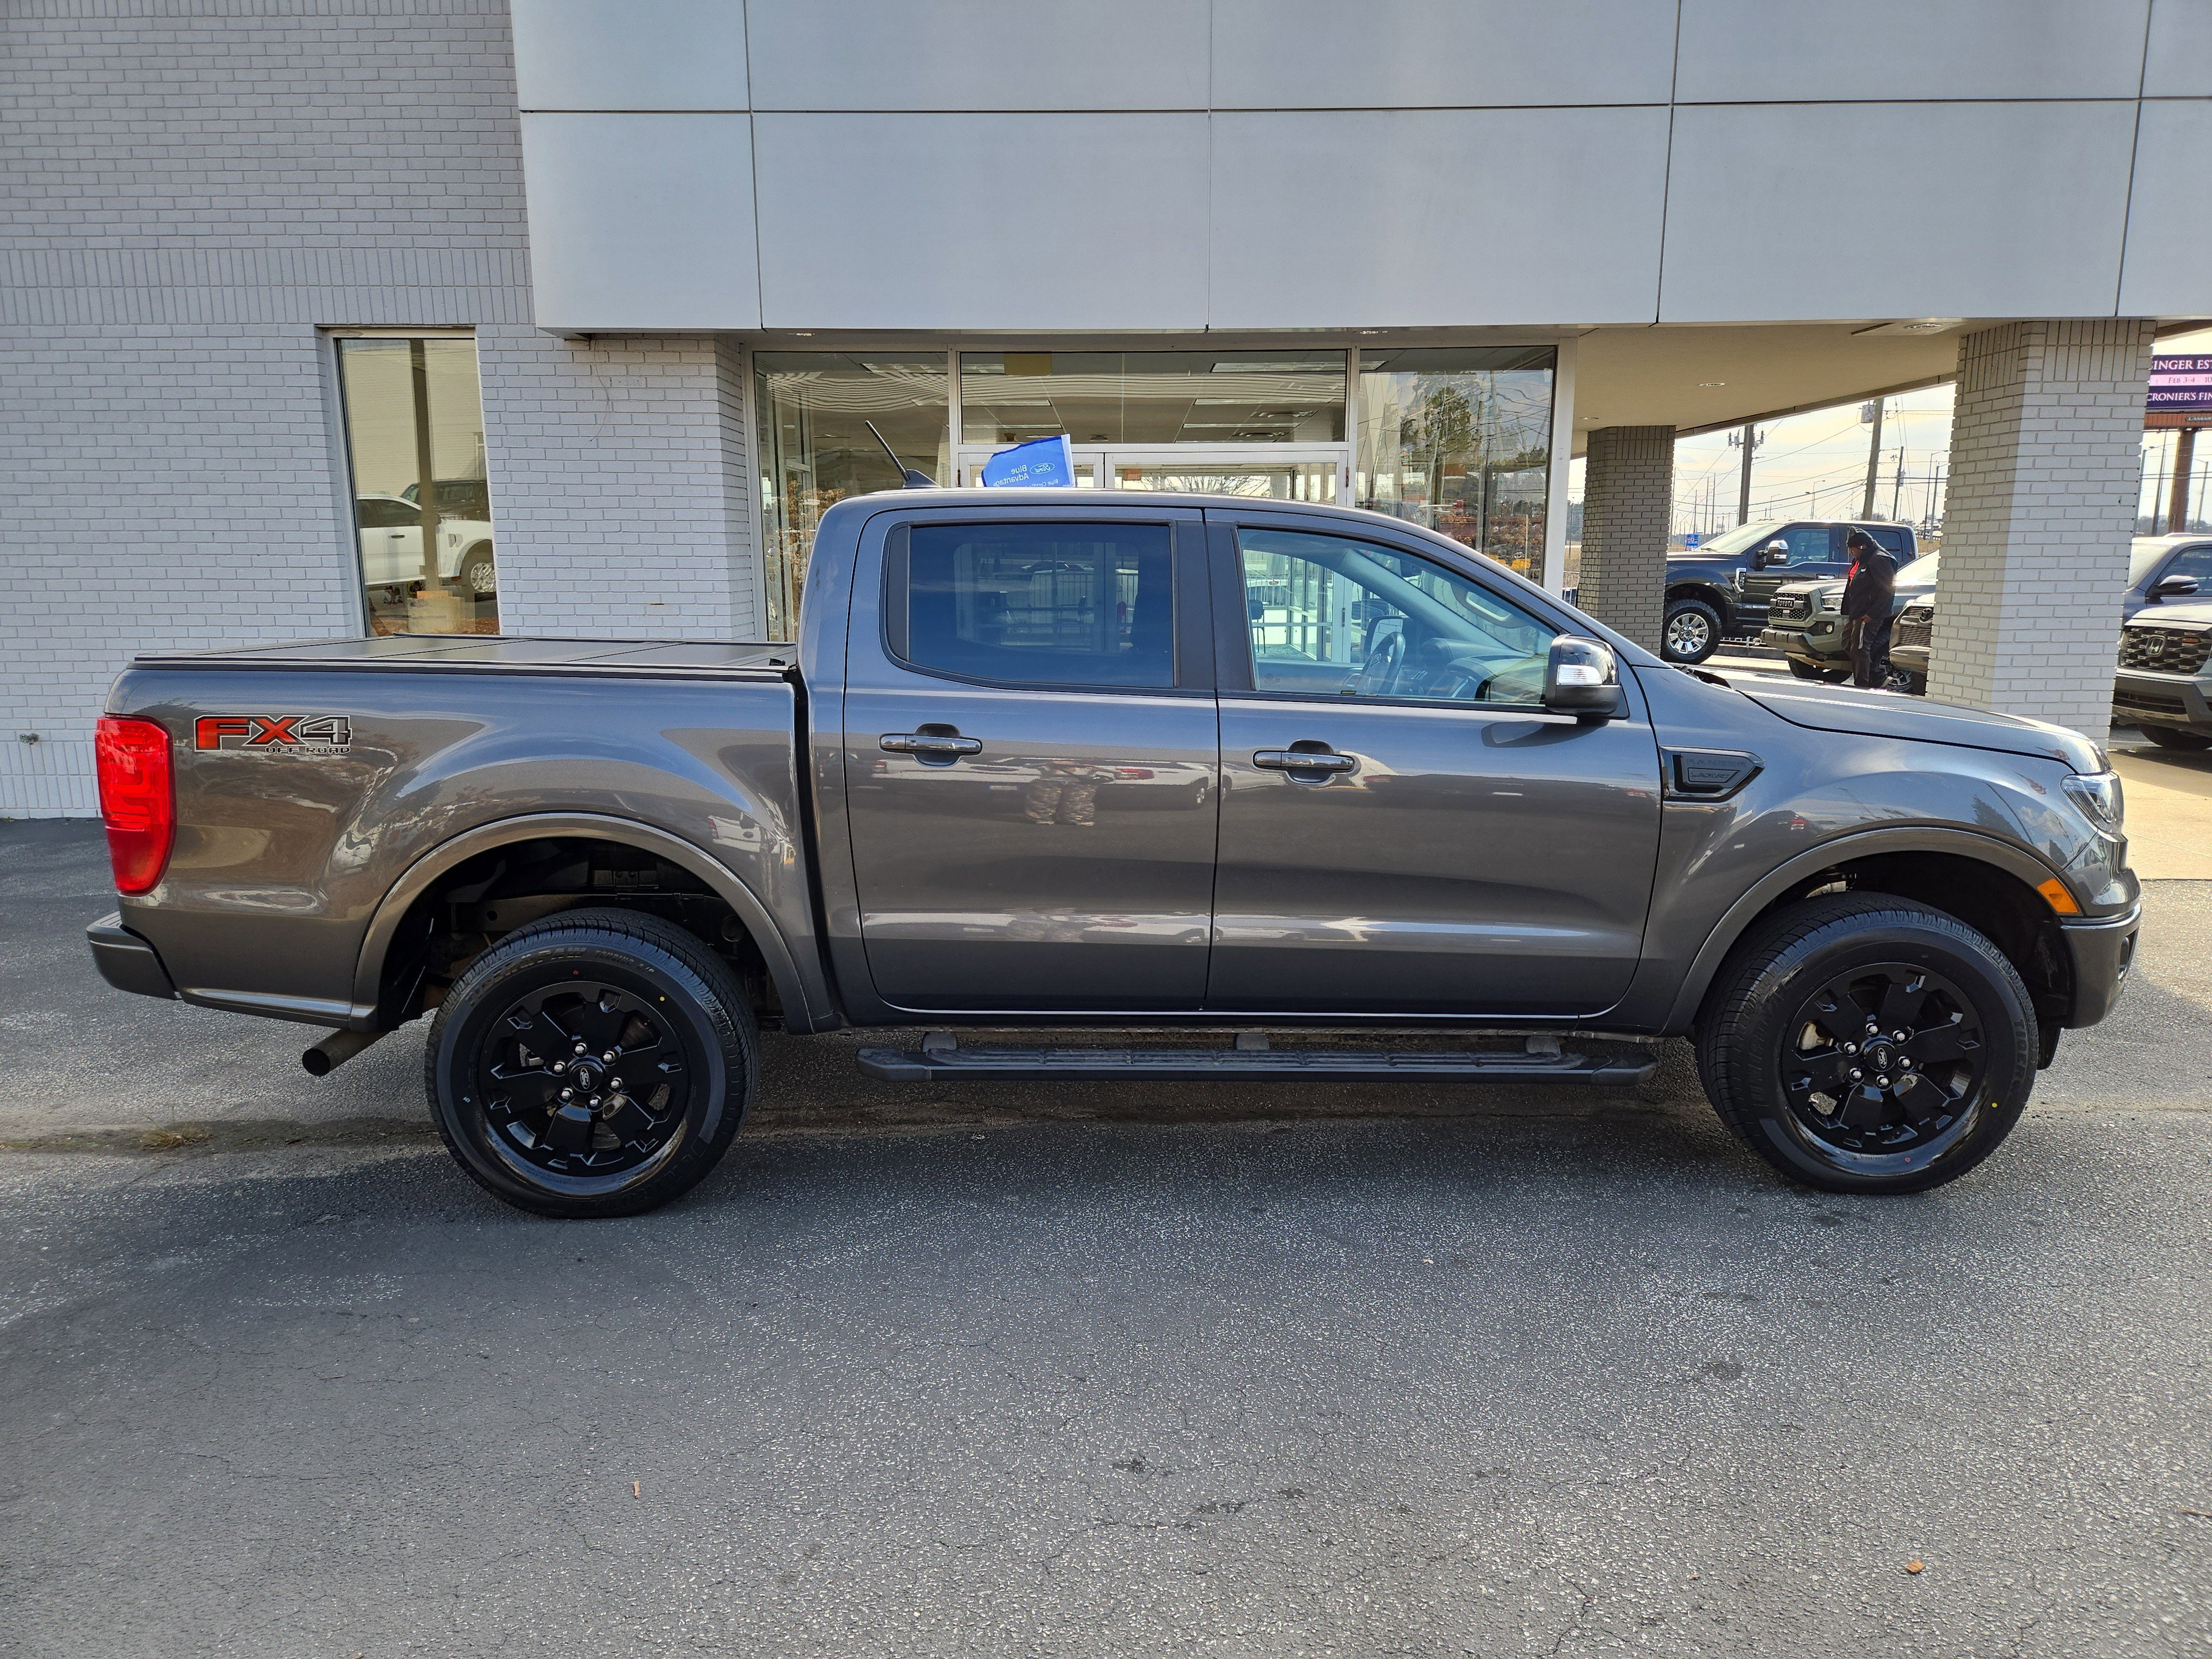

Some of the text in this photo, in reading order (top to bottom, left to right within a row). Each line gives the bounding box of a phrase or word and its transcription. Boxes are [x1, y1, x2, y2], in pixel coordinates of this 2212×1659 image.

[194, 715, 352, 752] FX4
[265, 746, 351, 754] OFF ROAD
[1687, 758, 1746, 767] RANGER
[1878, 1050, 1887, 1066] Ford
[581, 1070, 589, 1087] Ford
